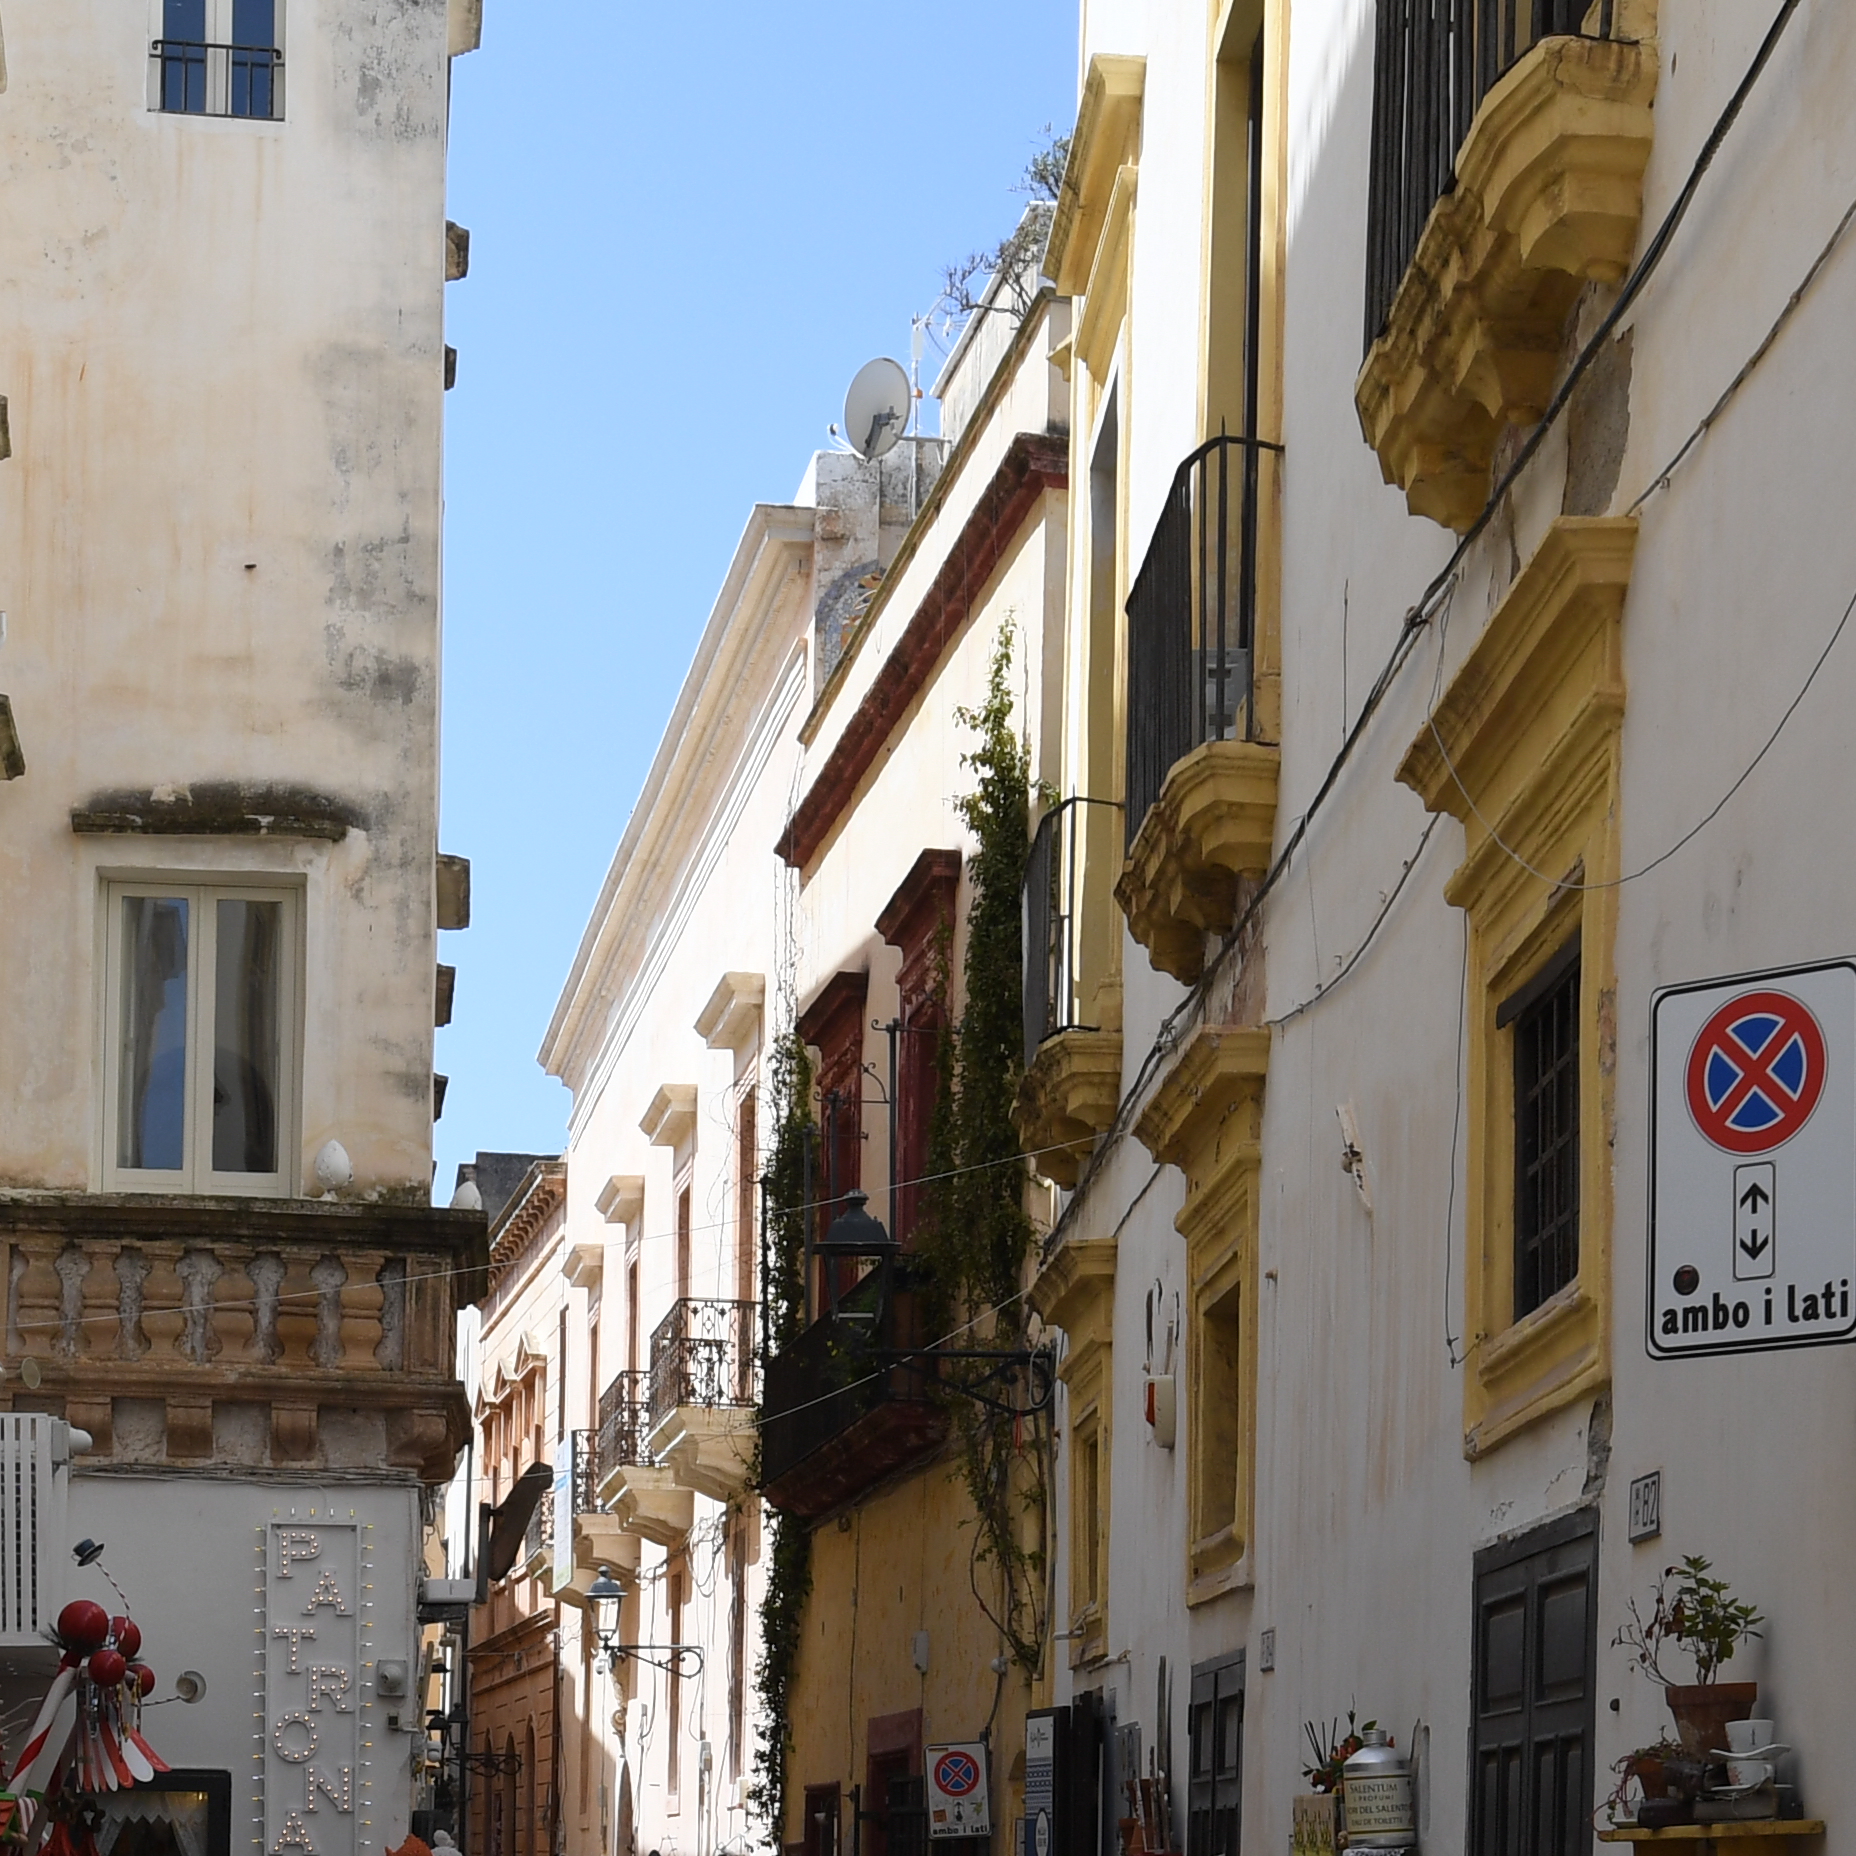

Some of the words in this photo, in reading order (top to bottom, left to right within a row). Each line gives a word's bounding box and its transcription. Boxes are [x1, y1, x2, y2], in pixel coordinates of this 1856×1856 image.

[1661, 1291, 1750, 1335] ambo
[1763, 1286, 1773, 1326] i
[1787, 1278, 1849, 1324] lati
[1642, 1480, 1657, 1527] 82
[1349, 1783, 1398, 1794] SALENTUM
[1358, 1794, 1395, 1802] PROFUMI
[1360, 1806, 1374, 1815] DEL
[932, 1825, 959, 1836] ambo
[970, 1824, 988, 1834] lati
